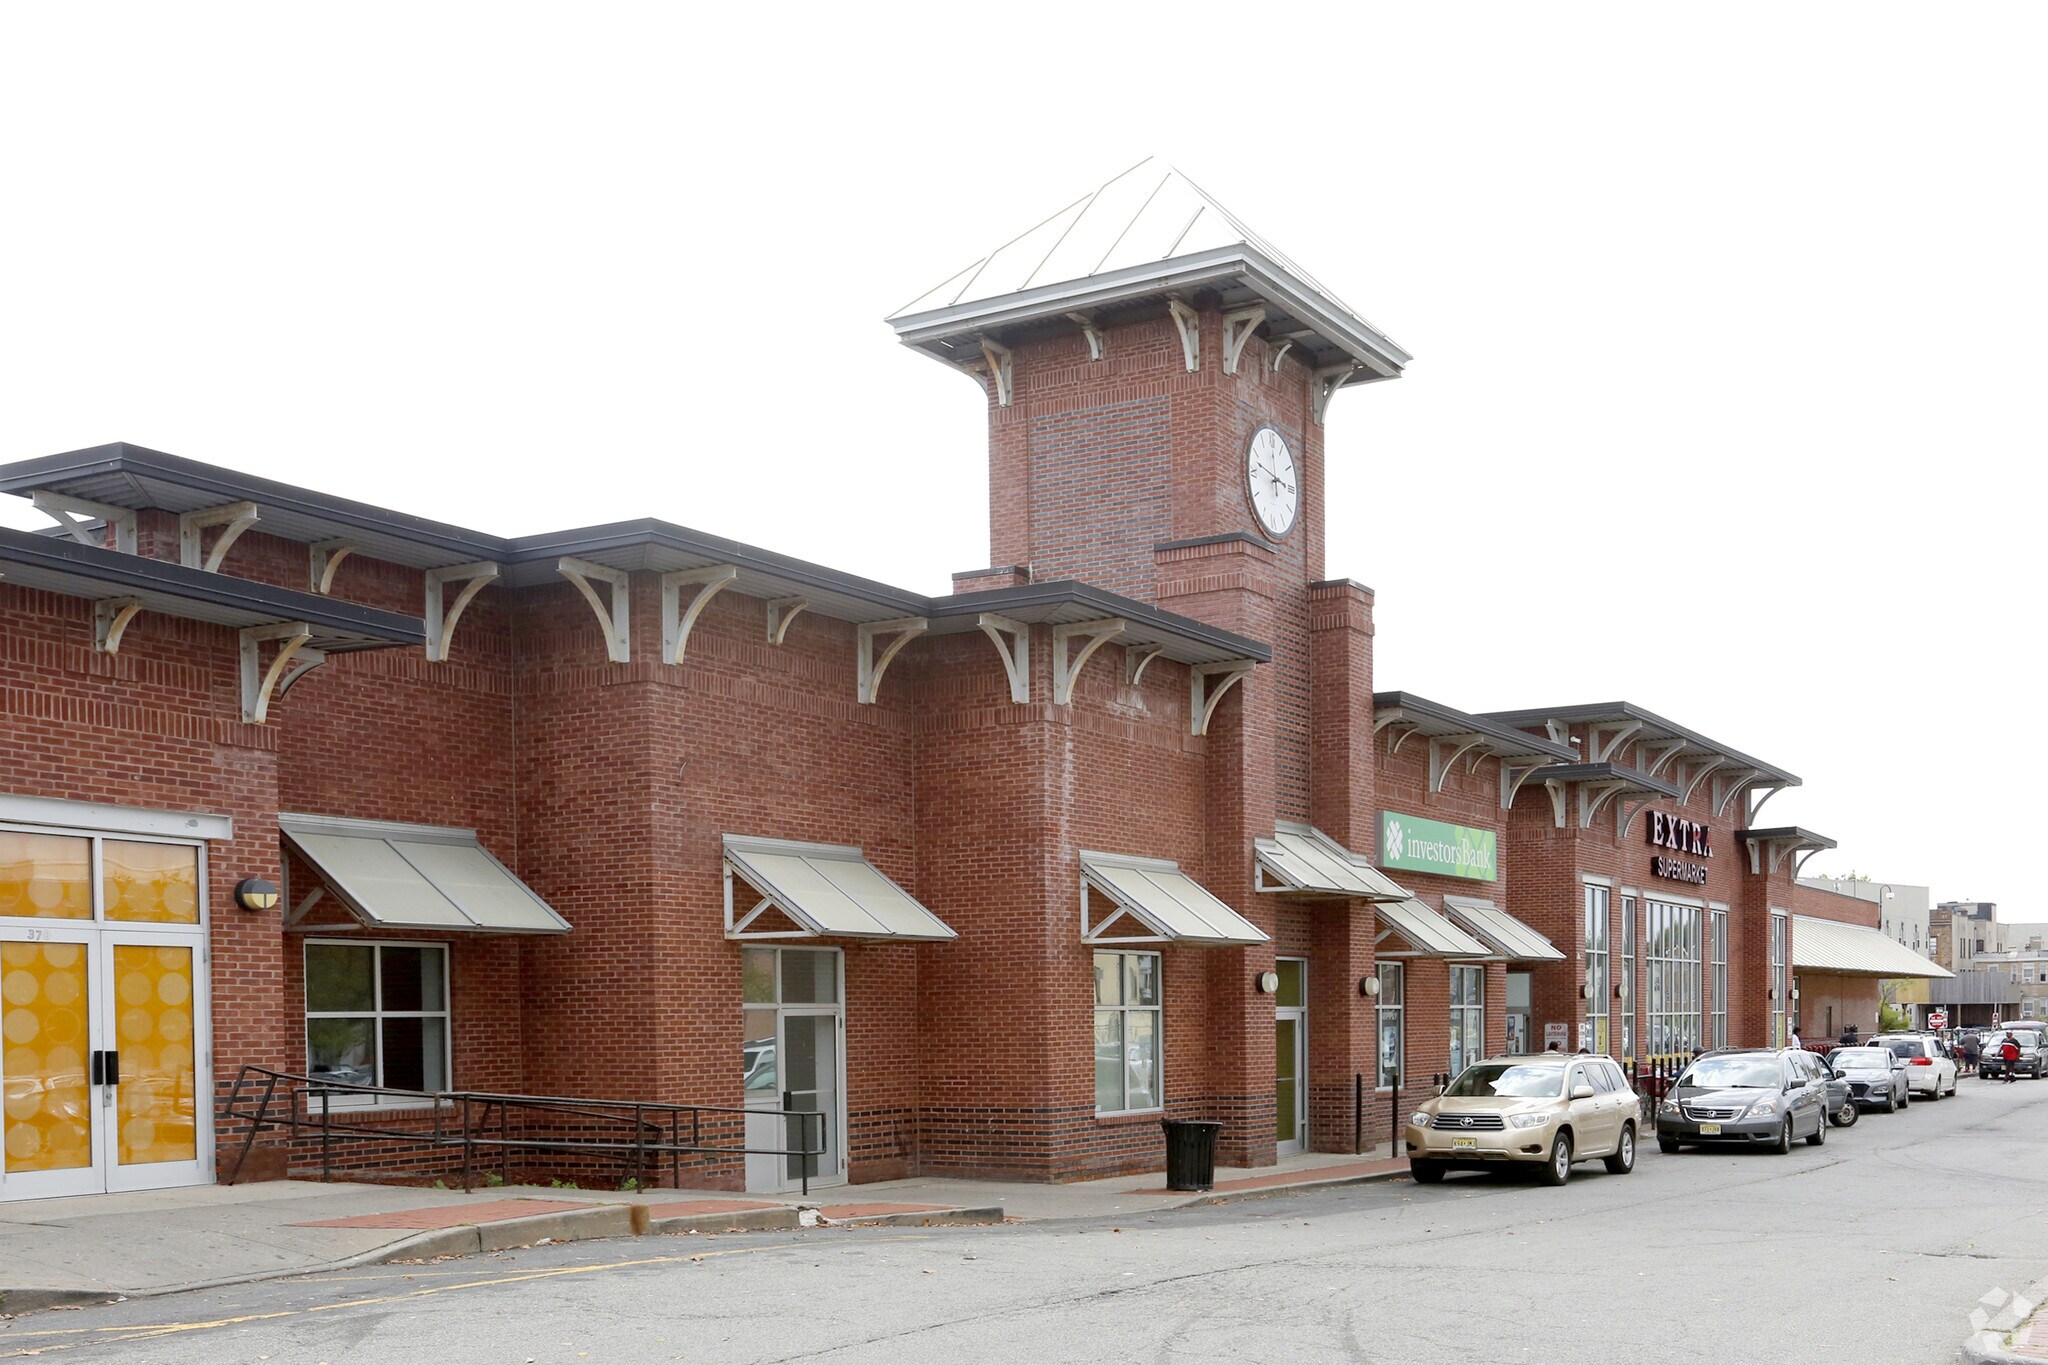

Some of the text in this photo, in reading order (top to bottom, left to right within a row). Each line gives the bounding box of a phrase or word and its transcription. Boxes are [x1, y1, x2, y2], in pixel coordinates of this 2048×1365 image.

[1407, 828, 1491, 868] investorsBank
[1652, 810, 1714, 858] EXTRA
[1657, 856, 1709, 885] SUPERMARKET
